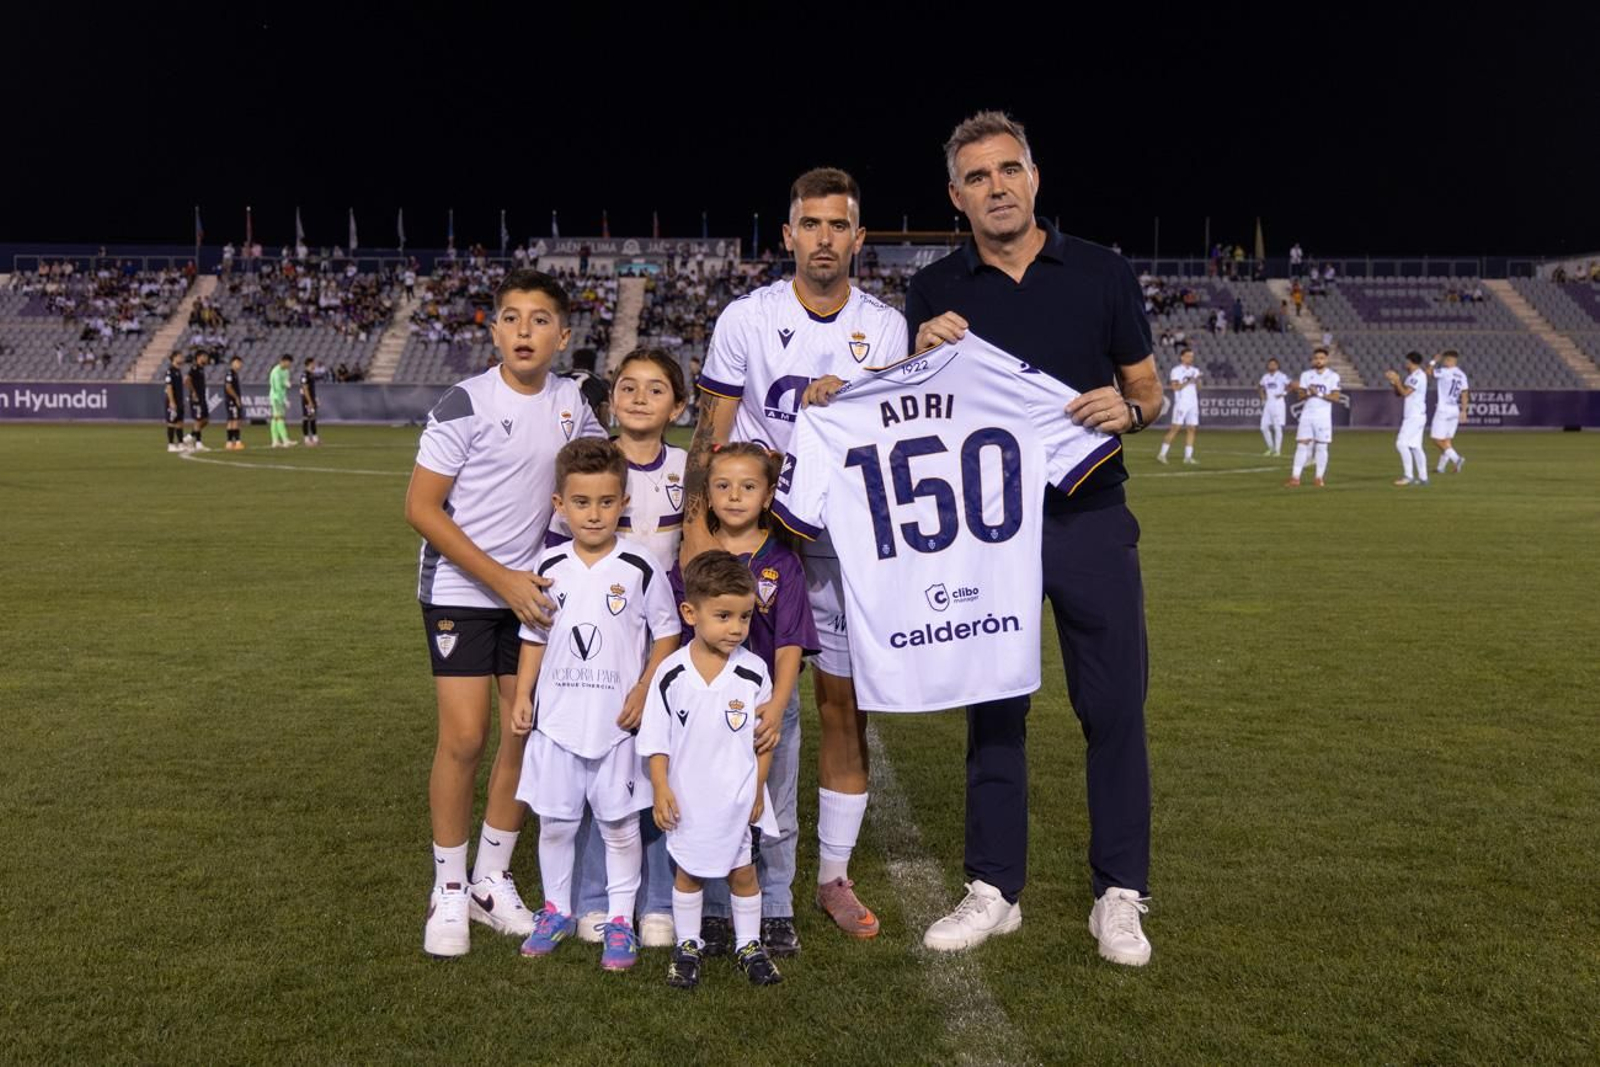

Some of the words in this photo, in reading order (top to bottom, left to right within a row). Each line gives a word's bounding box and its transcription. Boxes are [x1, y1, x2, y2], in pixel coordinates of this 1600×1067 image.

[901, 359, 929, 375] 1922
[14, 389, 108, 412] Hyundai
[1469, 393, 1514, 402] VEZAS
[879, 393, 955, 428] ADRI
[1201, 407, 1263, 417] EGURIDA
[1467, 403, 1520, 416] TORIA
[844, 427, 1023, 561] 150
[952, 587, 979, 599] clibo
